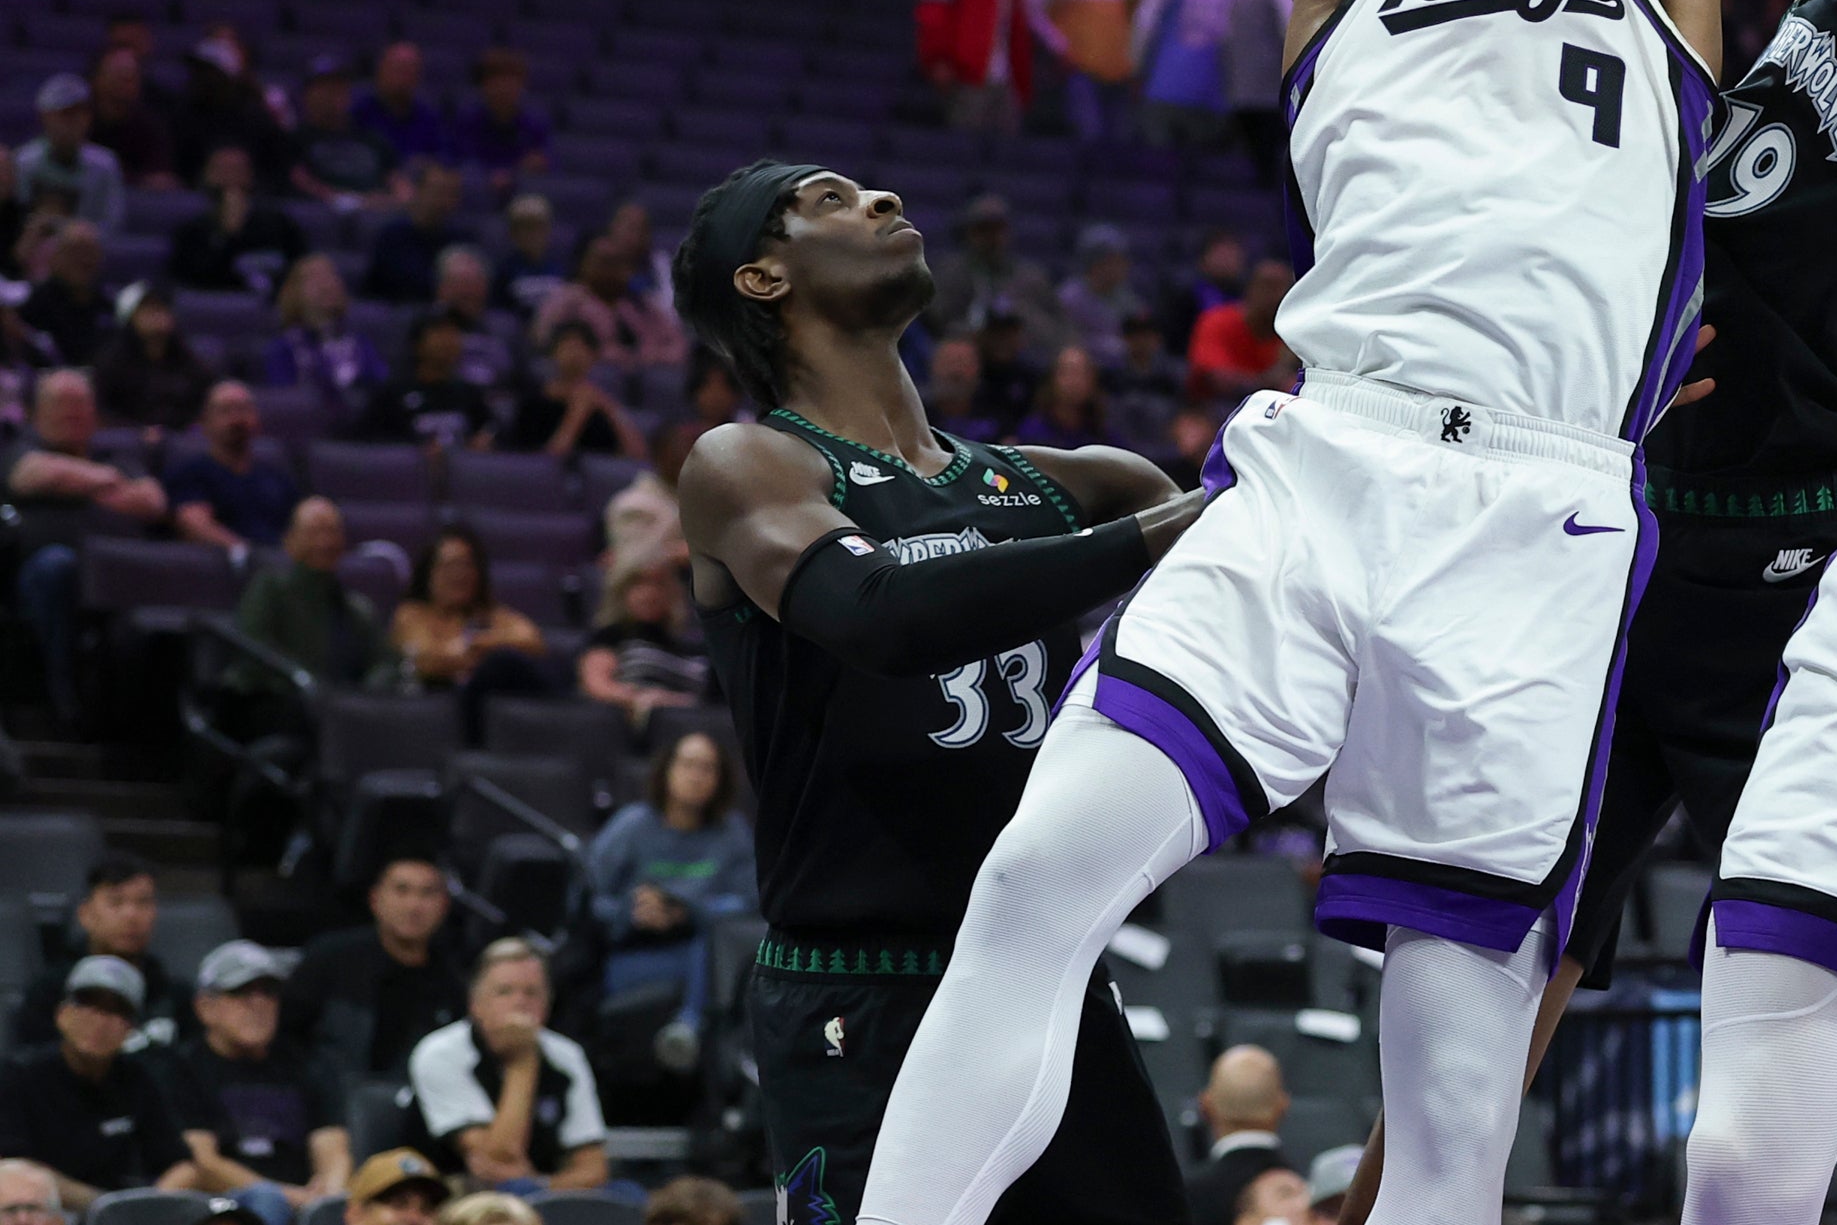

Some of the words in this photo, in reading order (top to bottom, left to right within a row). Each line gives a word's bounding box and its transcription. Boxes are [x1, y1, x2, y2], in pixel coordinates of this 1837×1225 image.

[1558, 41, 1626, 149] 9
[977, 492, 1041, 507] sezzle
[1773, 548, 1813, 571] NIKE
[928, 639, 1050, 749] 33
